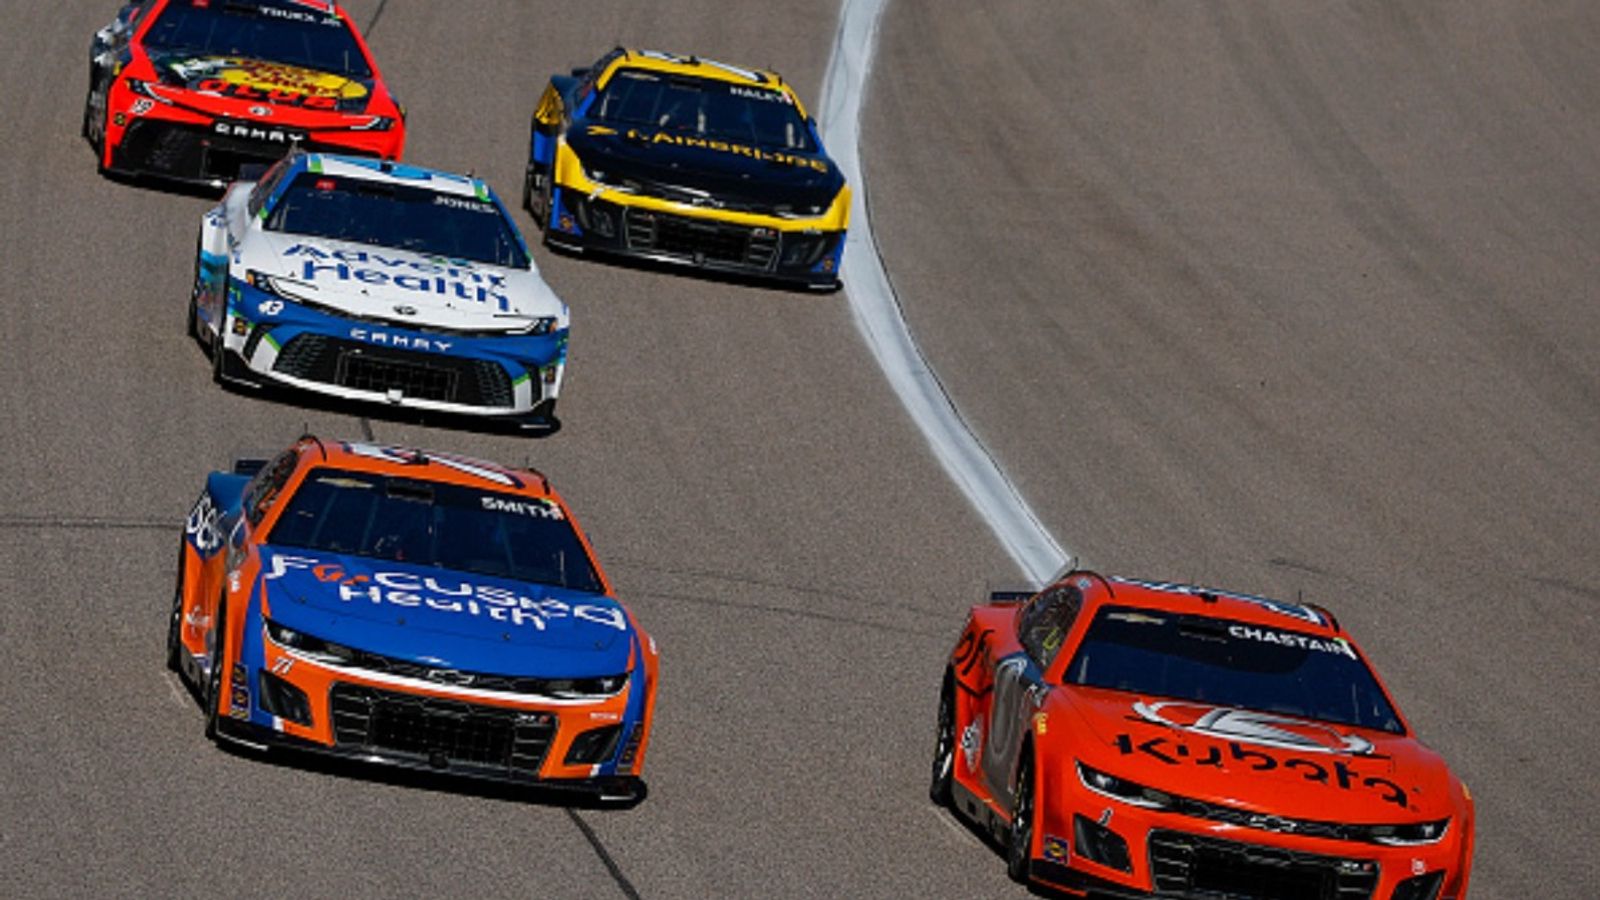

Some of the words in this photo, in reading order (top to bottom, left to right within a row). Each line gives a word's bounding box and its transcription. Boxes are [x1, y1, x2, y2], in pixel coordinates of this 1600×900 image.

[215, 122, 303, 142] CAMRY
[283, 244, 506, 288] Advent
[303, 260, 509, 312] Health
[350, 328, 453, 351] CAMRY
[481, 496, 560, 520] SMITH
[339, 584, 547, 631] Health
[1228, 626, 1344, 655] CHASTAIN
[1113, 733, 1408, 809] Kubota
